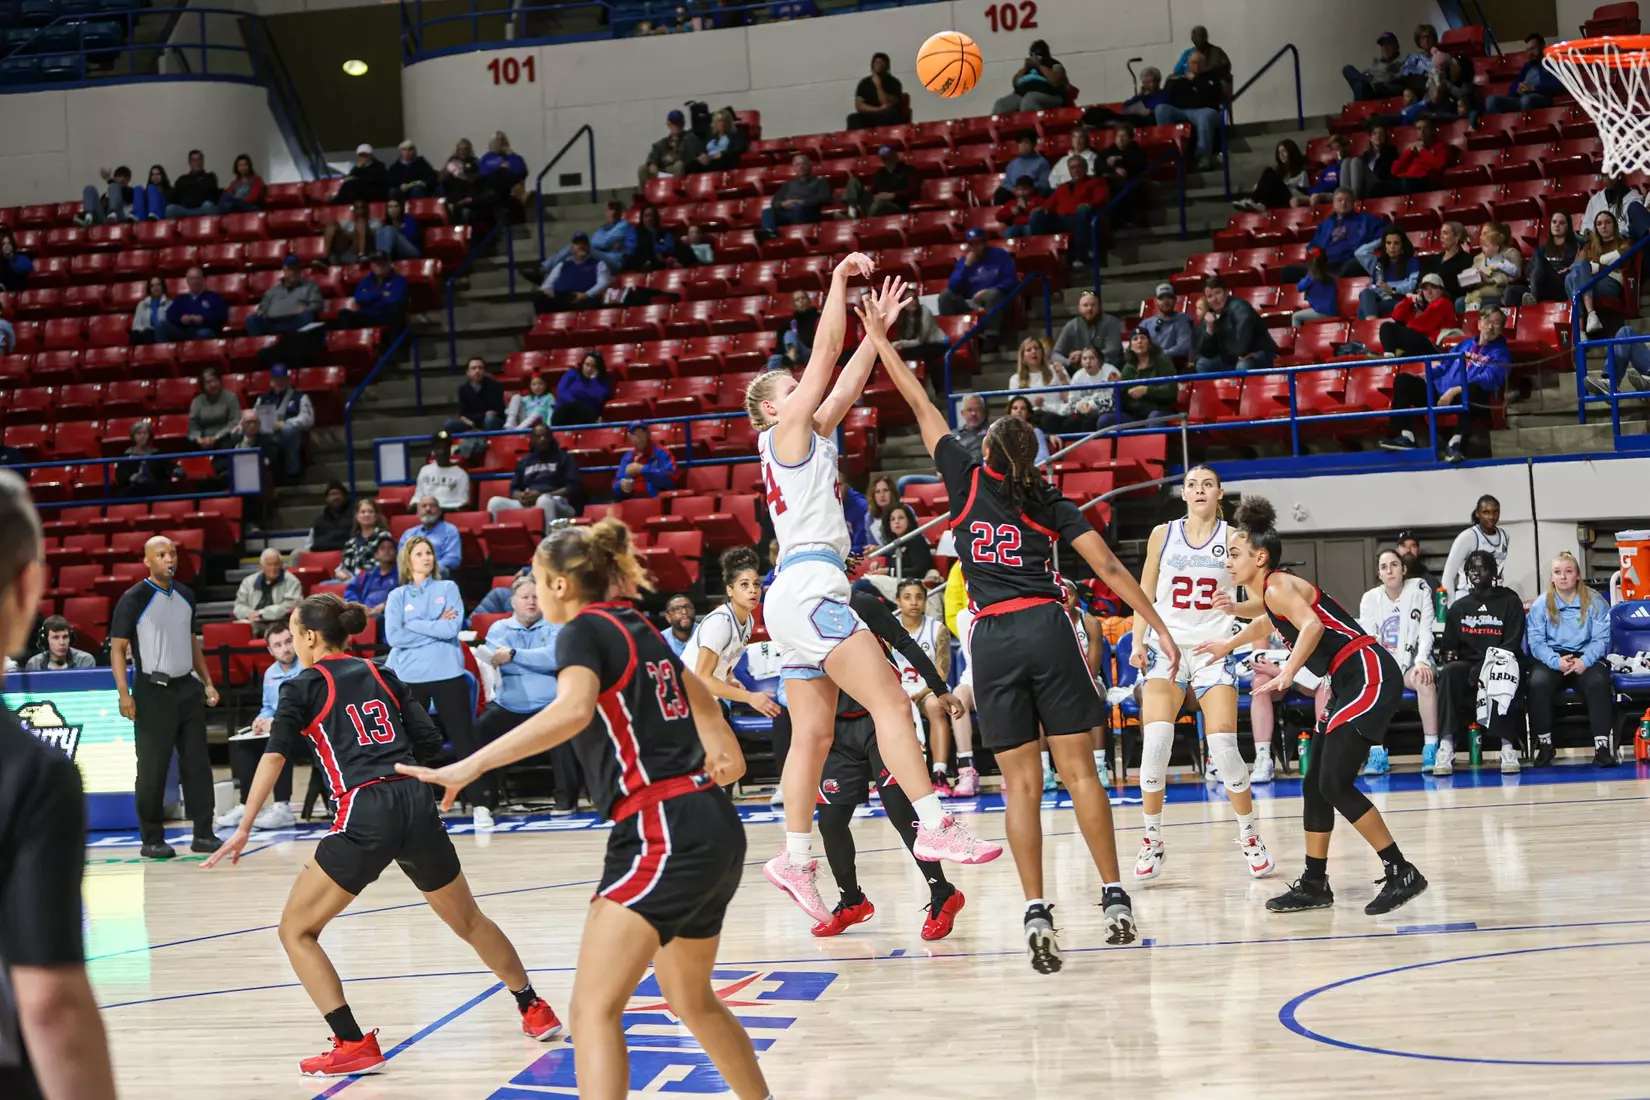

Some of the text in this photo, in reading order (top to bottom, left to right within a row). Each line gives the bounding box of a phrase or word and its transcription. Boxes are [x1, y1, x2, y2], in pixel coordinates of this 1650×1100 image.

[984, 1, 1038, 32] 102
[487, 54, 536, 85] 101
[970, 521, 1023, 567] 22
[1171, 576, 1218, 610] 23
[645, 659, 690, 721] 23
[345, 699, 396, 746] 13
